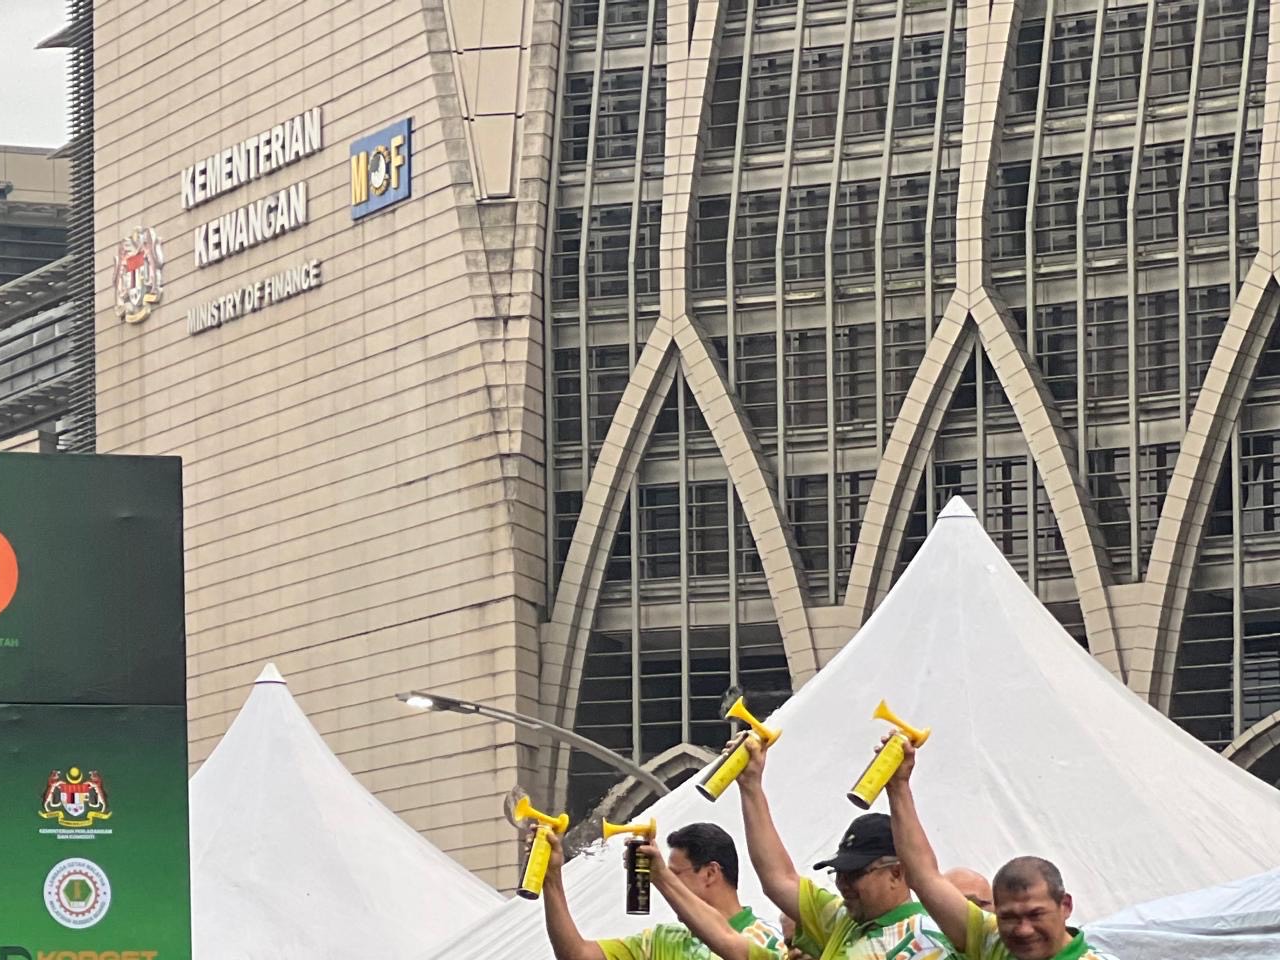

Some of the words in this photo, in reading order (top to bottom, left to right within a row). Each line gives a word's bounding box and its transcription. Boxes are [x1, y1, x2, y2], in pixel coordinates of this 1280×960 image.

[181, 107, 322, 210] KEMENTERIAN
[351, 134, 405, 206] MOF
[194, 181, 308, 267] KEWANGAN
[186, 289, 242, 335] MINISTRY
[243, 281, 263, 312] OF
[263, 258, 322, 303] FINANCE
